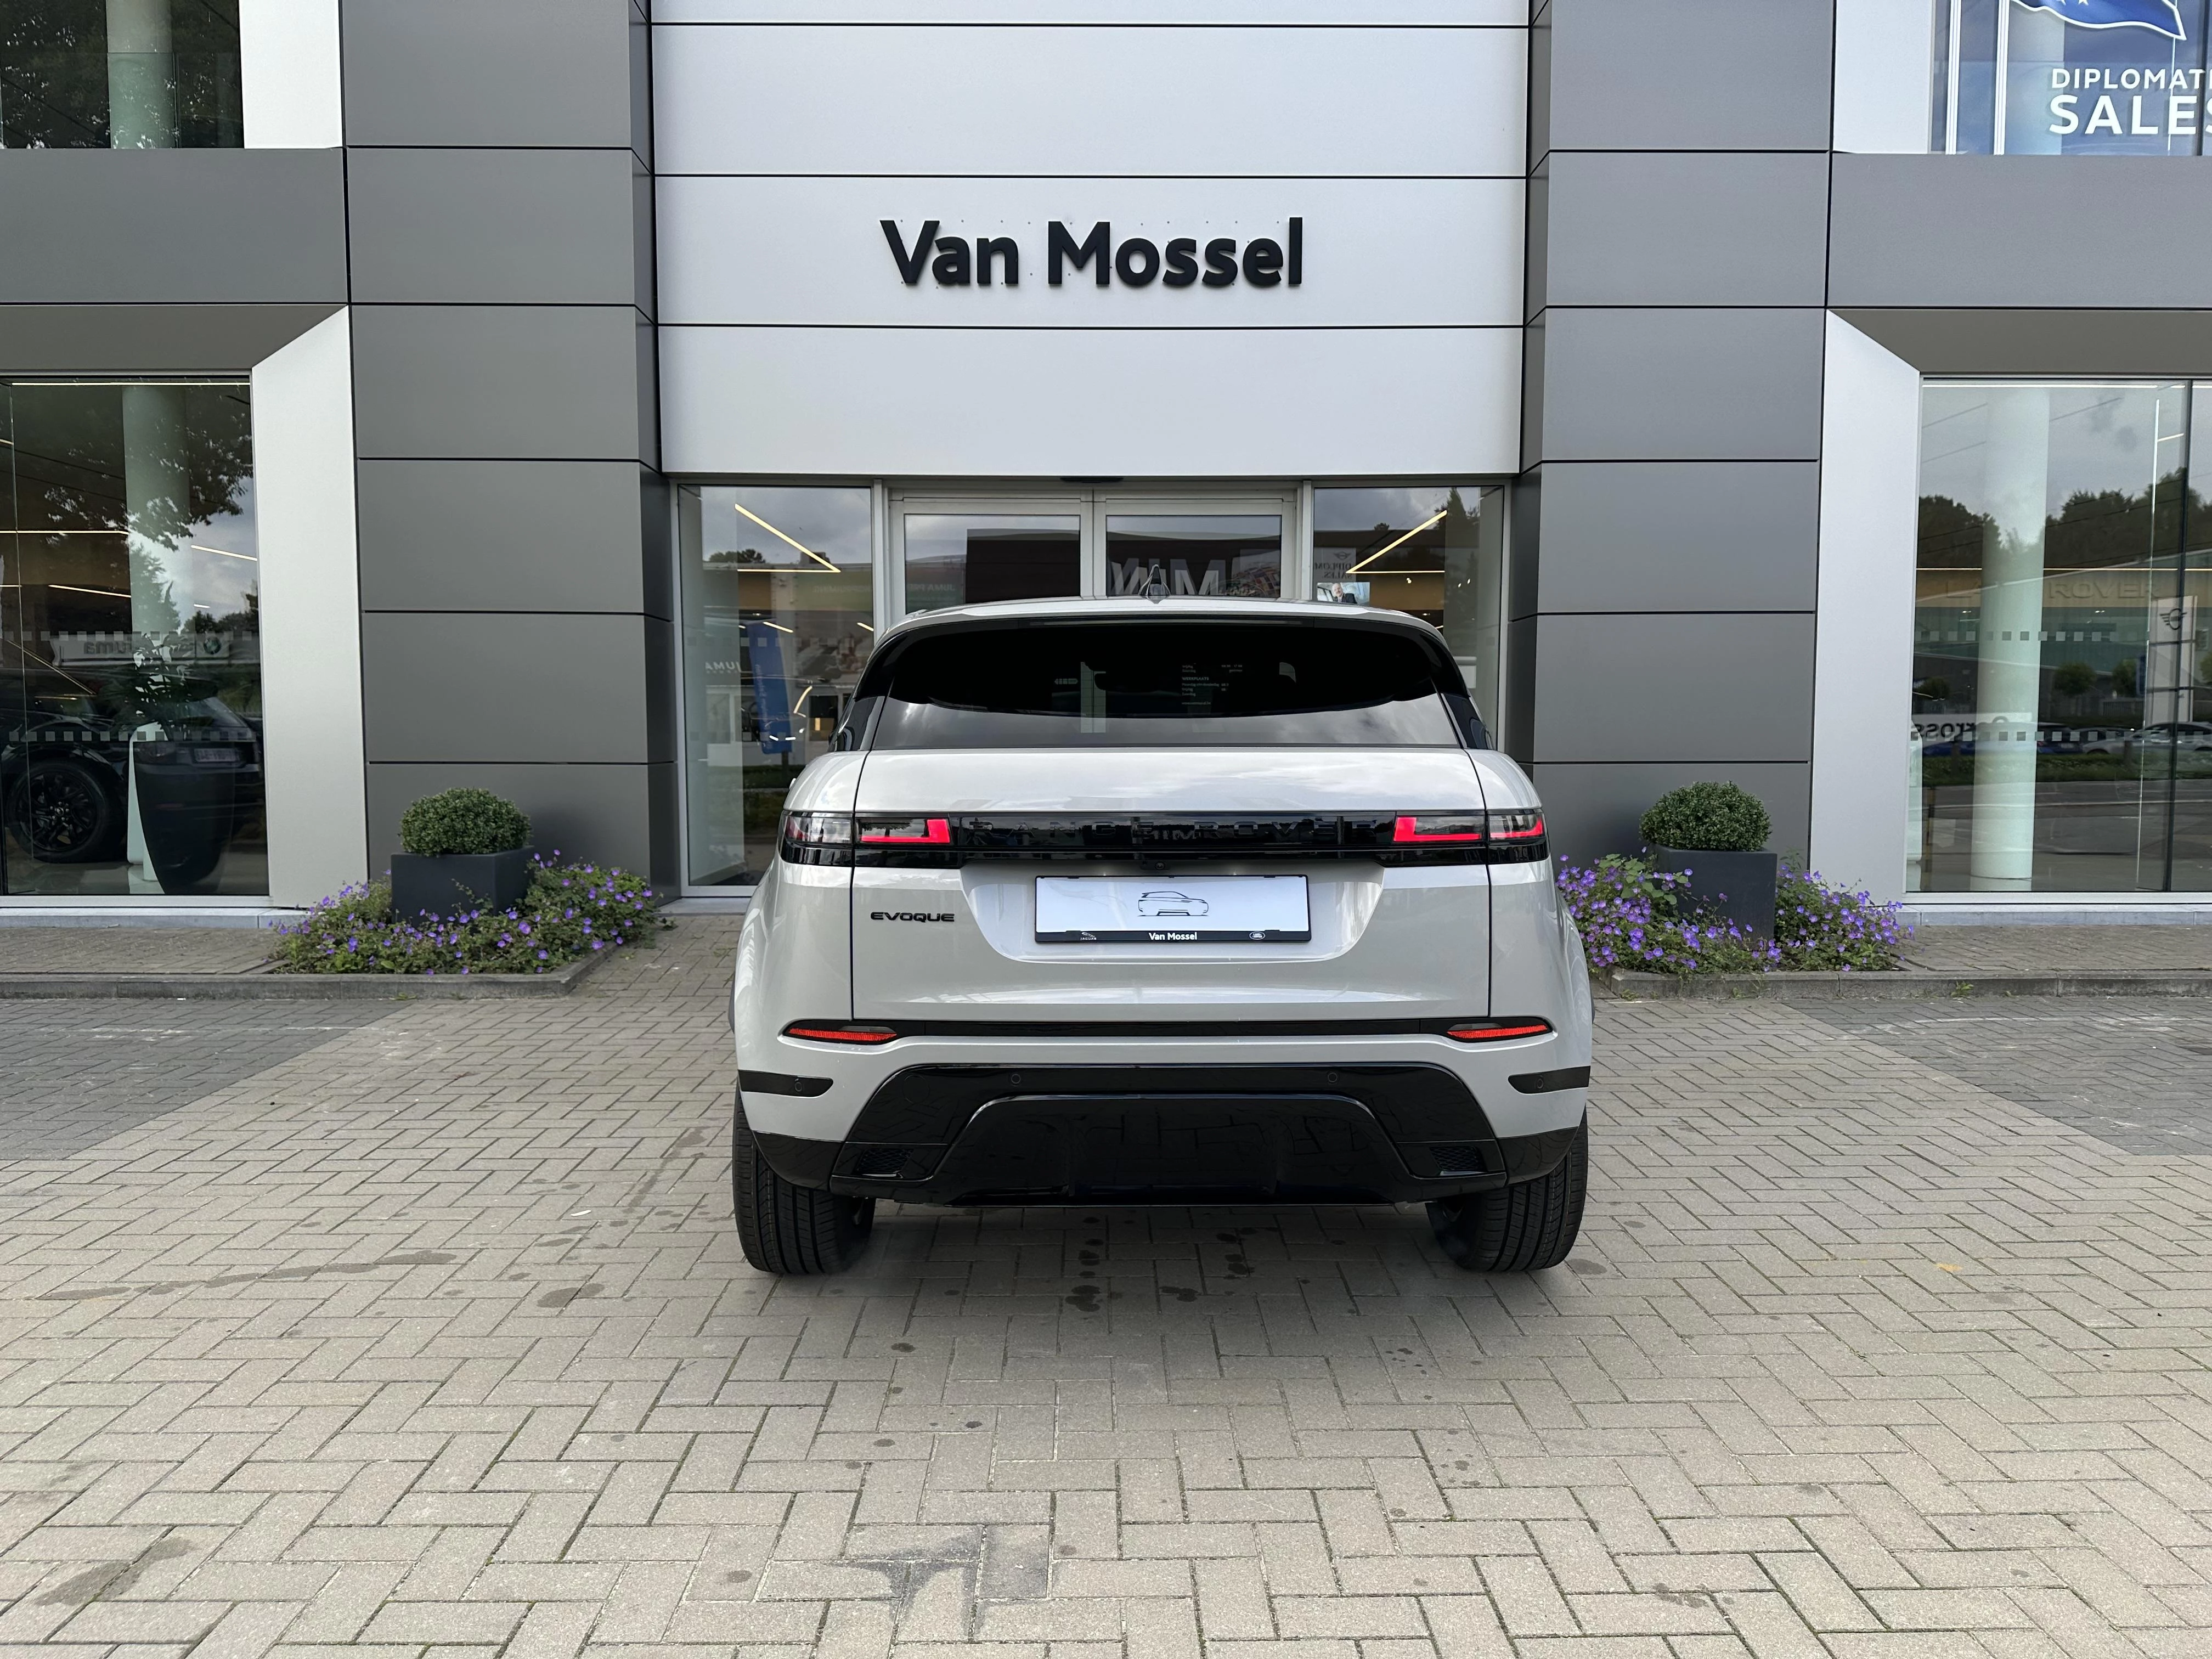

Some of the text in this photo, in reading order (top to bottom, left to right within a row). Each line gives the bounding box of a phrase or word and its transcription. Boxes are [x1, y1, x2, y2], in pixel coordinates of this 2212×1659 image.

[2049, 94, 2212, 135] SALE
[879, 217, 1303, 287] Van Mossel
[870, 911, 955, 922] EVOQUE
[1148, 932, 1197, 940] Van Mossel
